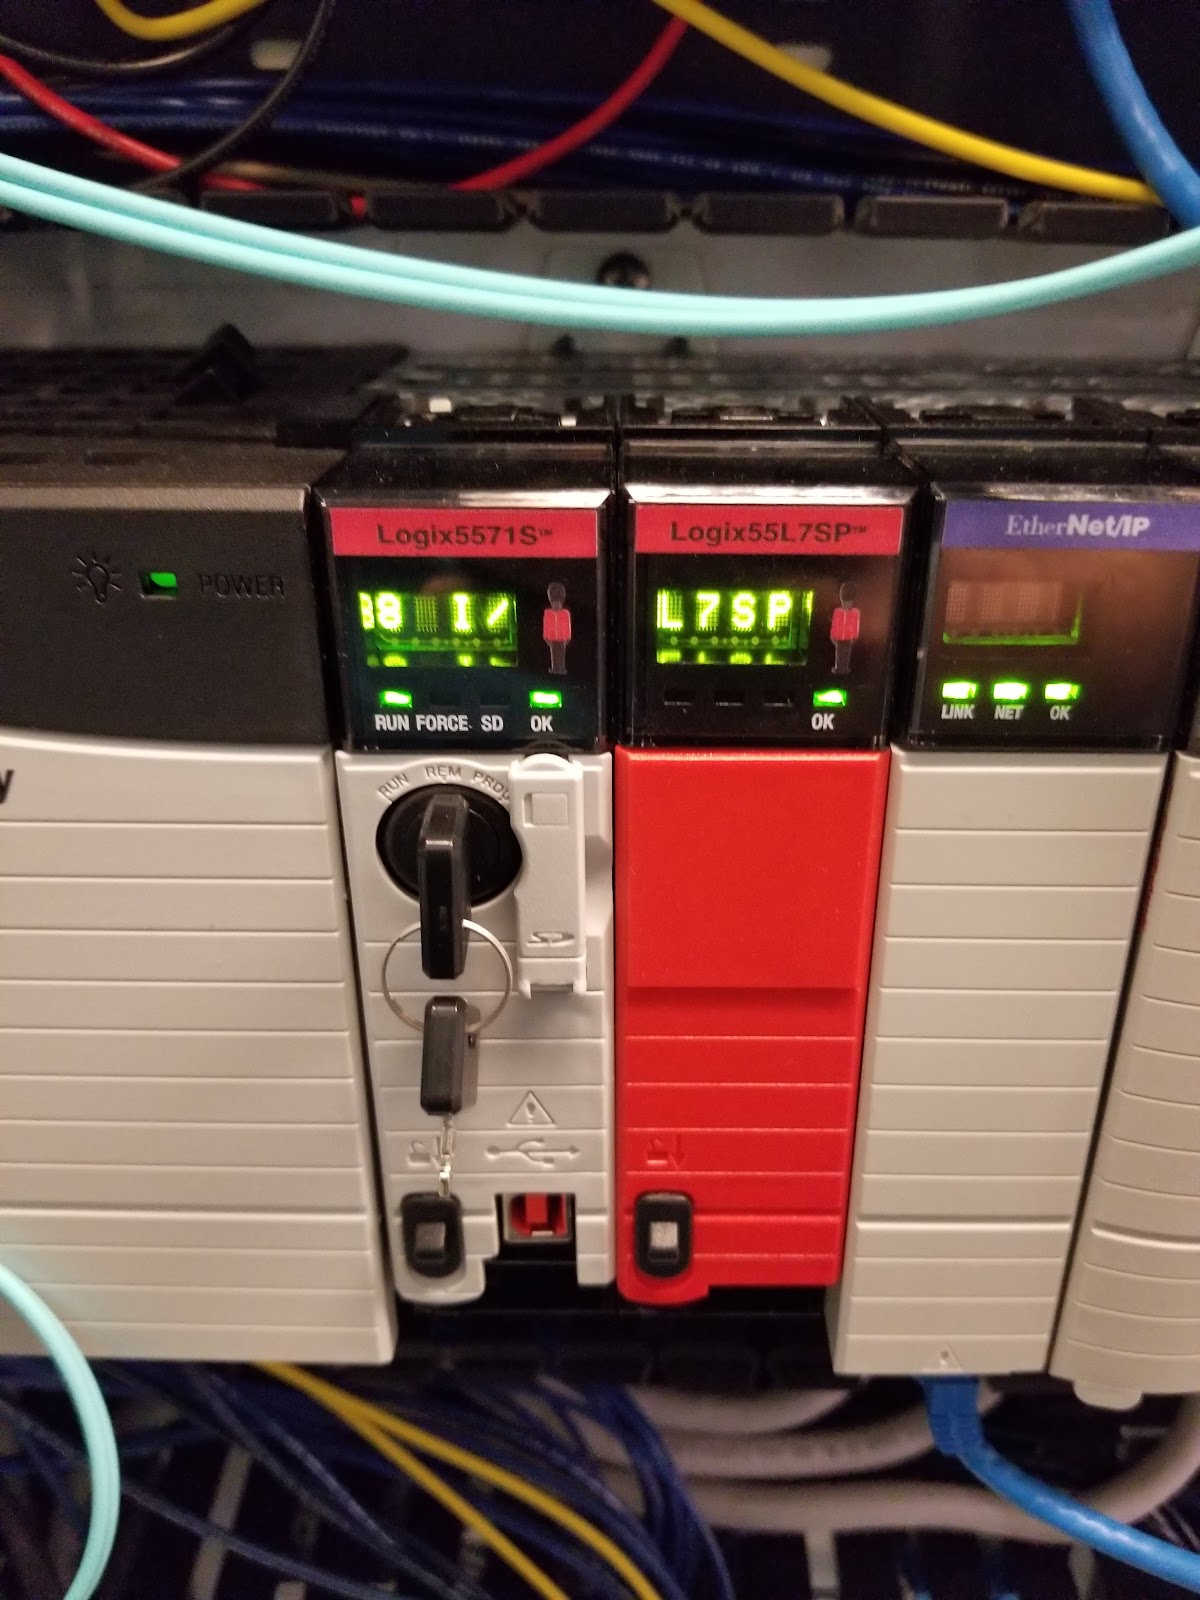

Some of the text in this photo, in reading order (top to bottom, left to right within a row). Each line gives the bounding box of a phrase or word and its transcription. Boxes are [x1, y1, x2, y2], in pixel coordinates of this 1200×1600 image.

[1004, 513, 1150, 538] EtherNet/IP
[199, 574, 286, 598] POWER
[811, 713, 835, 730] OK
[941, 704, 1071, 720] LINK NET OK
[374, 714, 554, 731] RUN FORCE SD OK
[378, 774, 410, 798] RUN
[424, 766, 462, 778] REM
